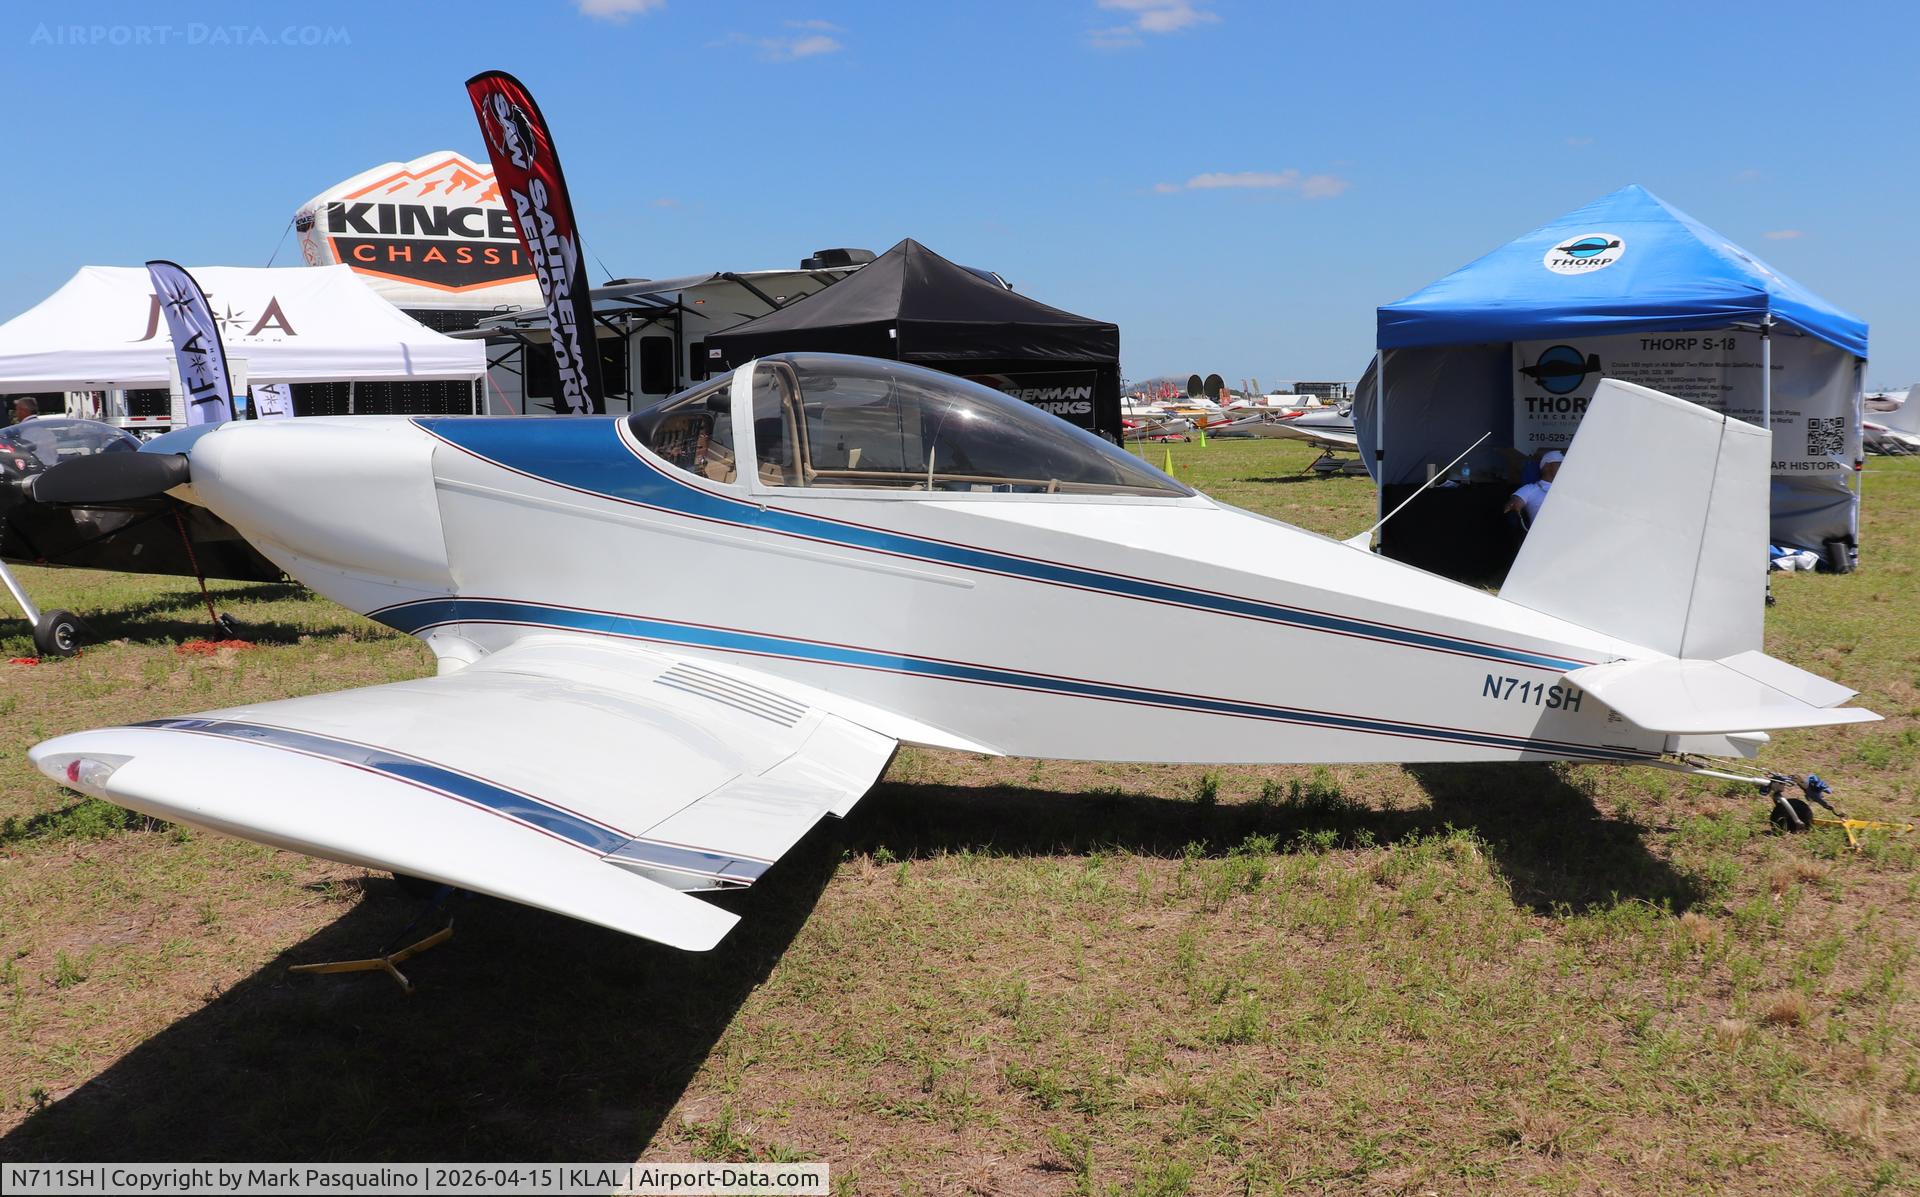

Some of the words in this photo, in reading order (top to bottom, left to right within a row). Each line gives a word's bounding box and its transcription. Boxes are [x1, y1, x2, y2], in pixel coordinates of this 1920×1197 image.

[353, 244, 532, 265] CHASSI
[1552, 258, 1613, 266] THORP
[1640, 338, 1698, 351] THORP
[1702, 338, 1736, 350] S-18
[1032, 402, 1092, 414] ORKS
[1524, 397, 1592, 413] THOR
[1482, 674, 1584, 713] N711SH
